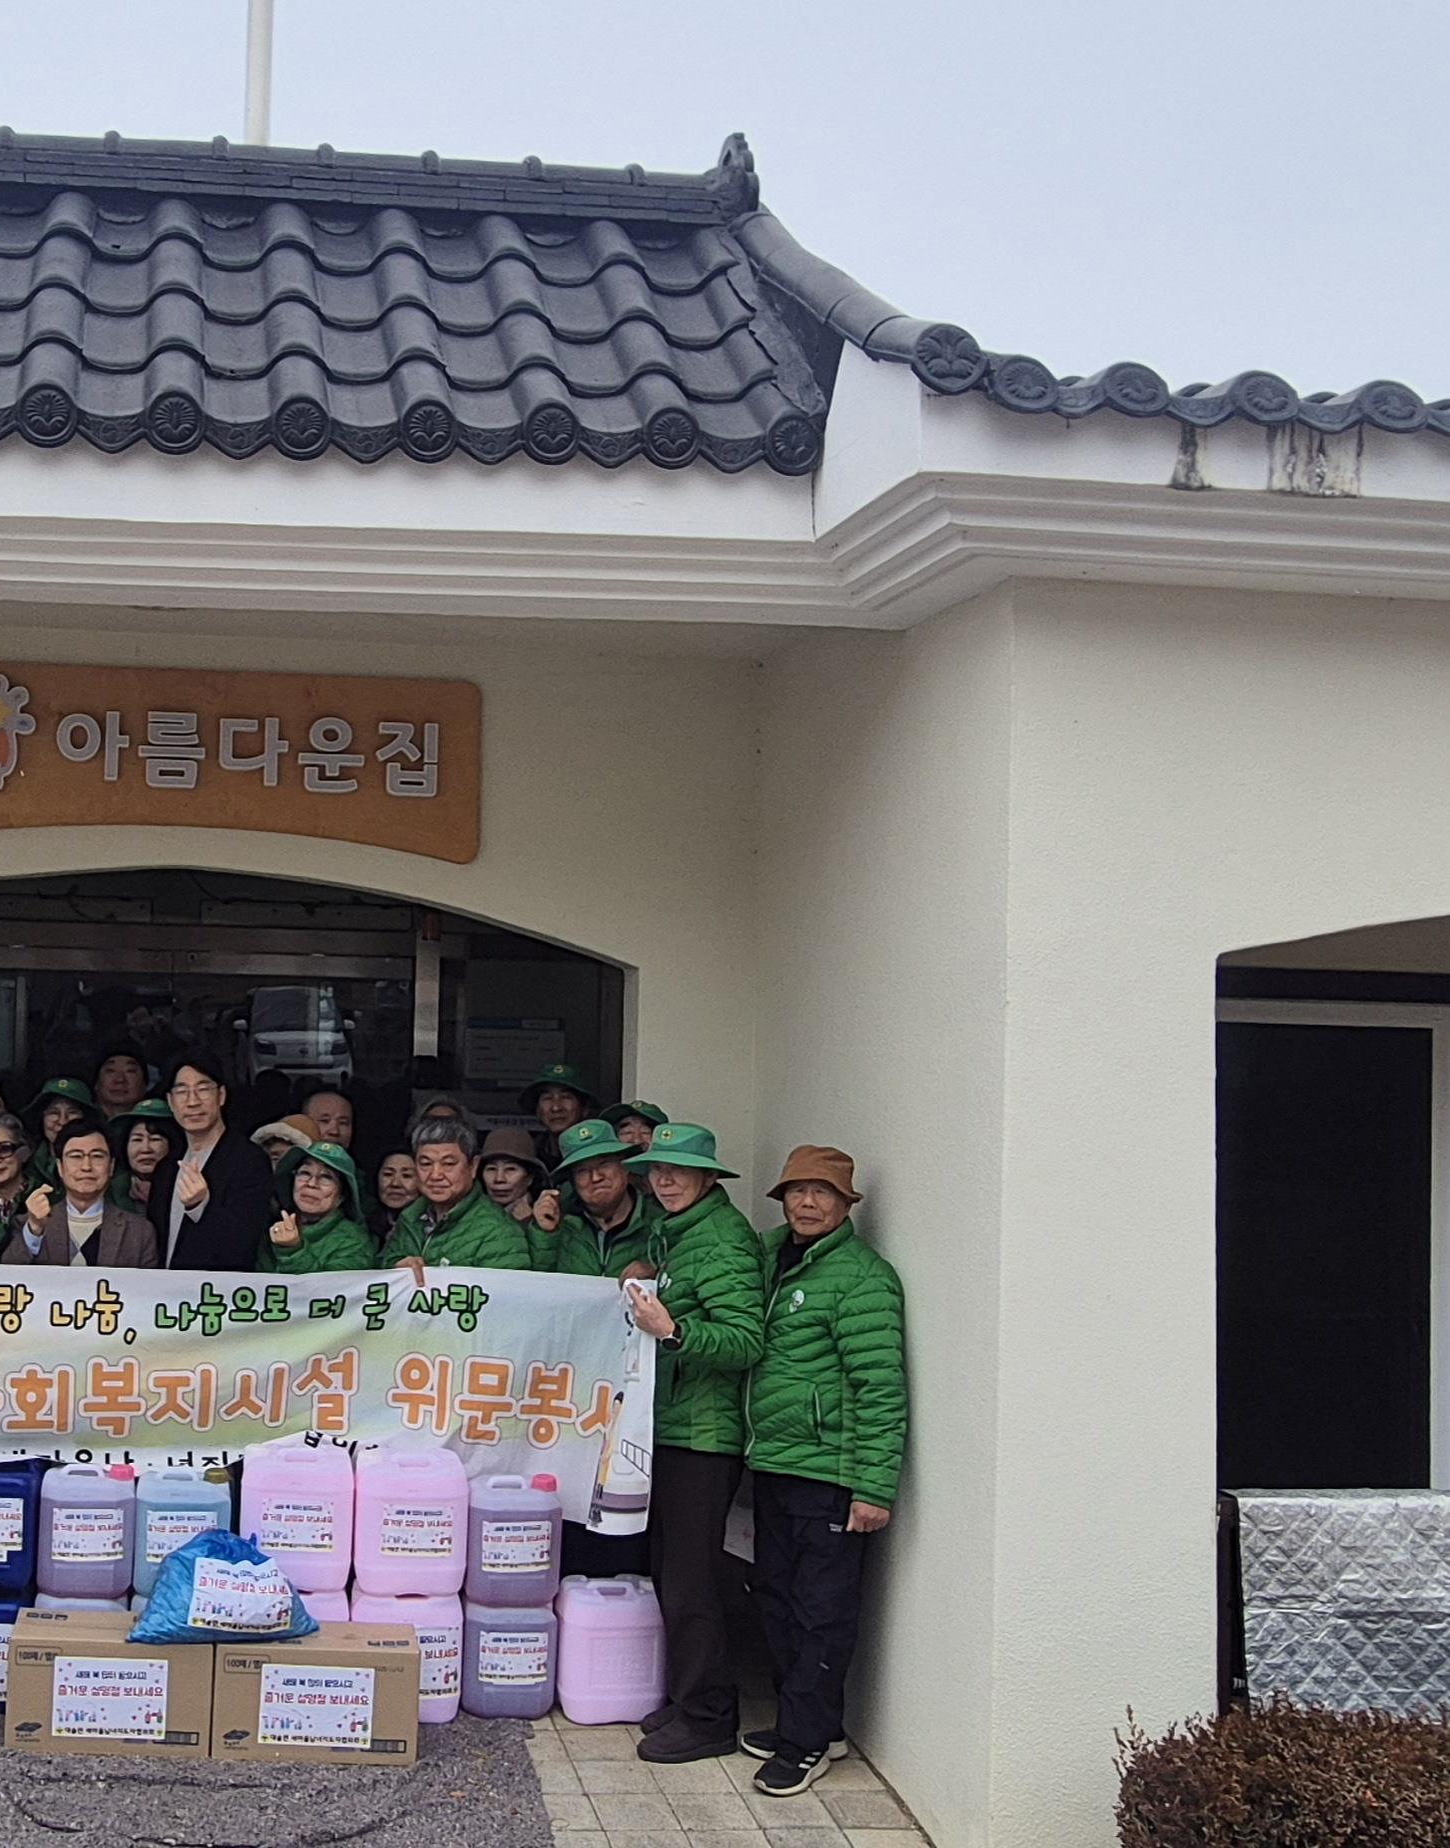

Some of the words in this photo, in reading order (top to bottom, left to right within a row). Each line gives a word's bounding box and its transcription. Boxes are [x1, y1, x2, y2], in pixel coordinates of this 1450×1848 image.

[56, 711, 440, 798] 아름다운집
[50, 1280, 137, 1344] 나눔,
[155, 1282, 291, 1336] 나눔으로
[309, 1295, 346, 1319] 더
[362, 1282, 391, 1330] 큰
[408, 1284, 489, 1332] 사랑
[123, 1687, 163, 1696] 보내세요
[330, 1694, 369, 1705] 보내세요
